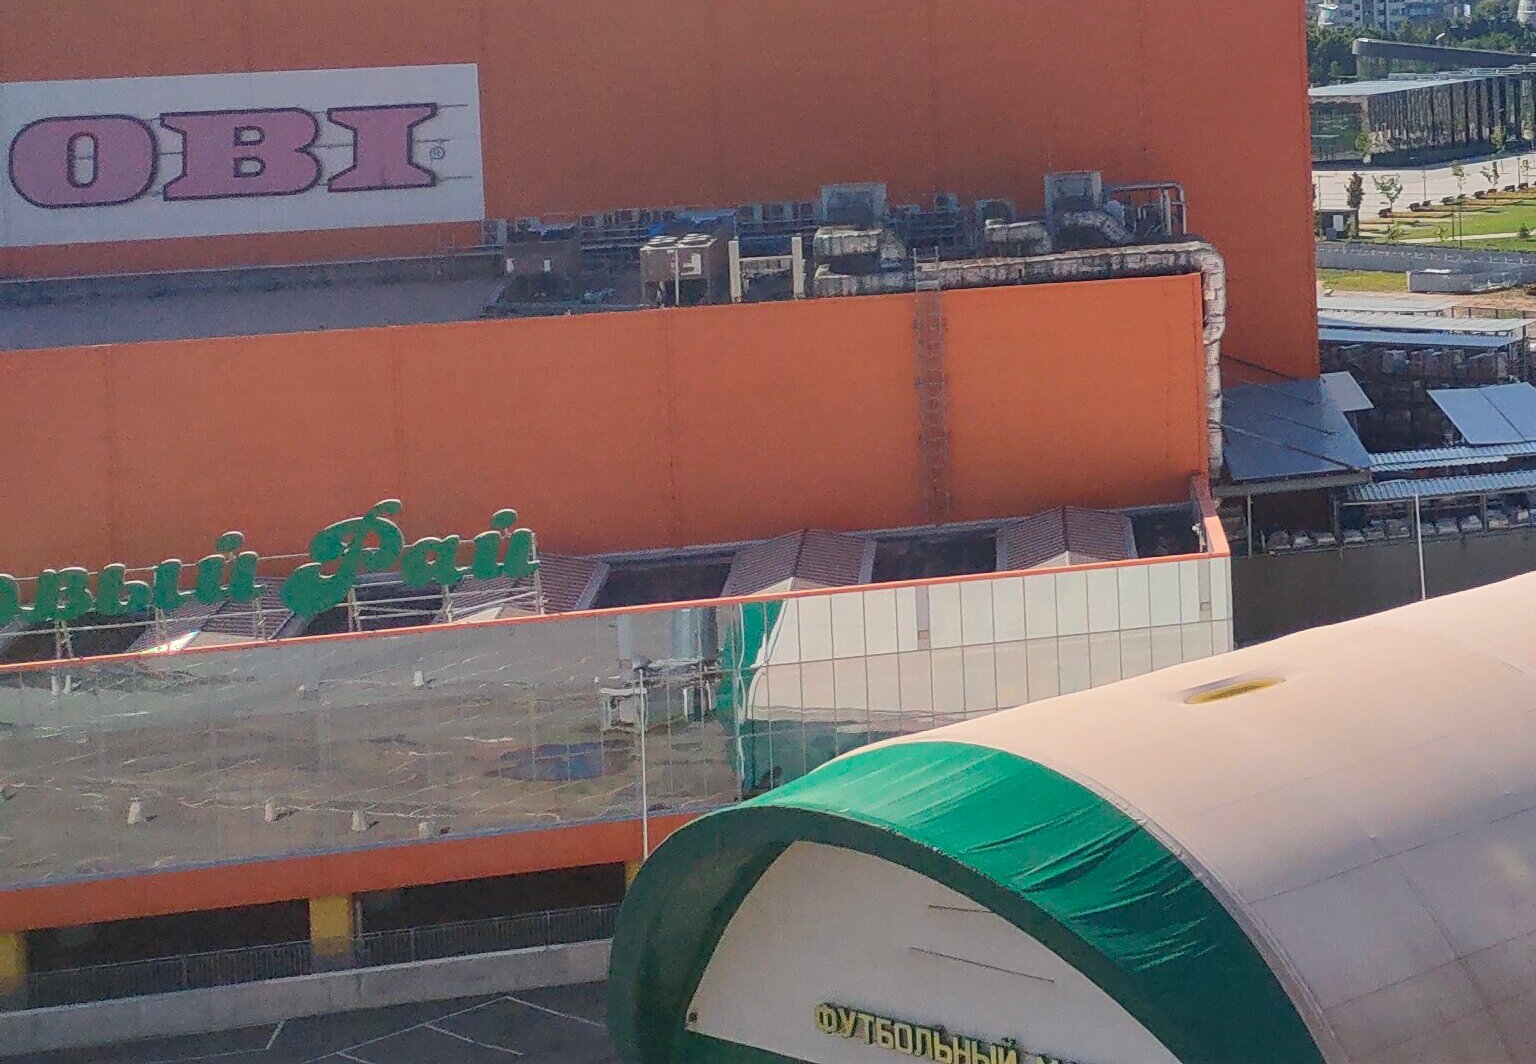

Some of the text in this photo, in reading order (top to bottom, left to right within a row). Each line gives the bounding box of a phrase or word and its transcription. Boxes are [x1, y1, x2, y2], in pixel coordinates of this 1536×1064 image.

[8, 102, 438, 209] OBI
[279, 499, 540, 618] Рай
[815, 1002, 1017, 1064] ФУТБОЛЬНЫЙ
